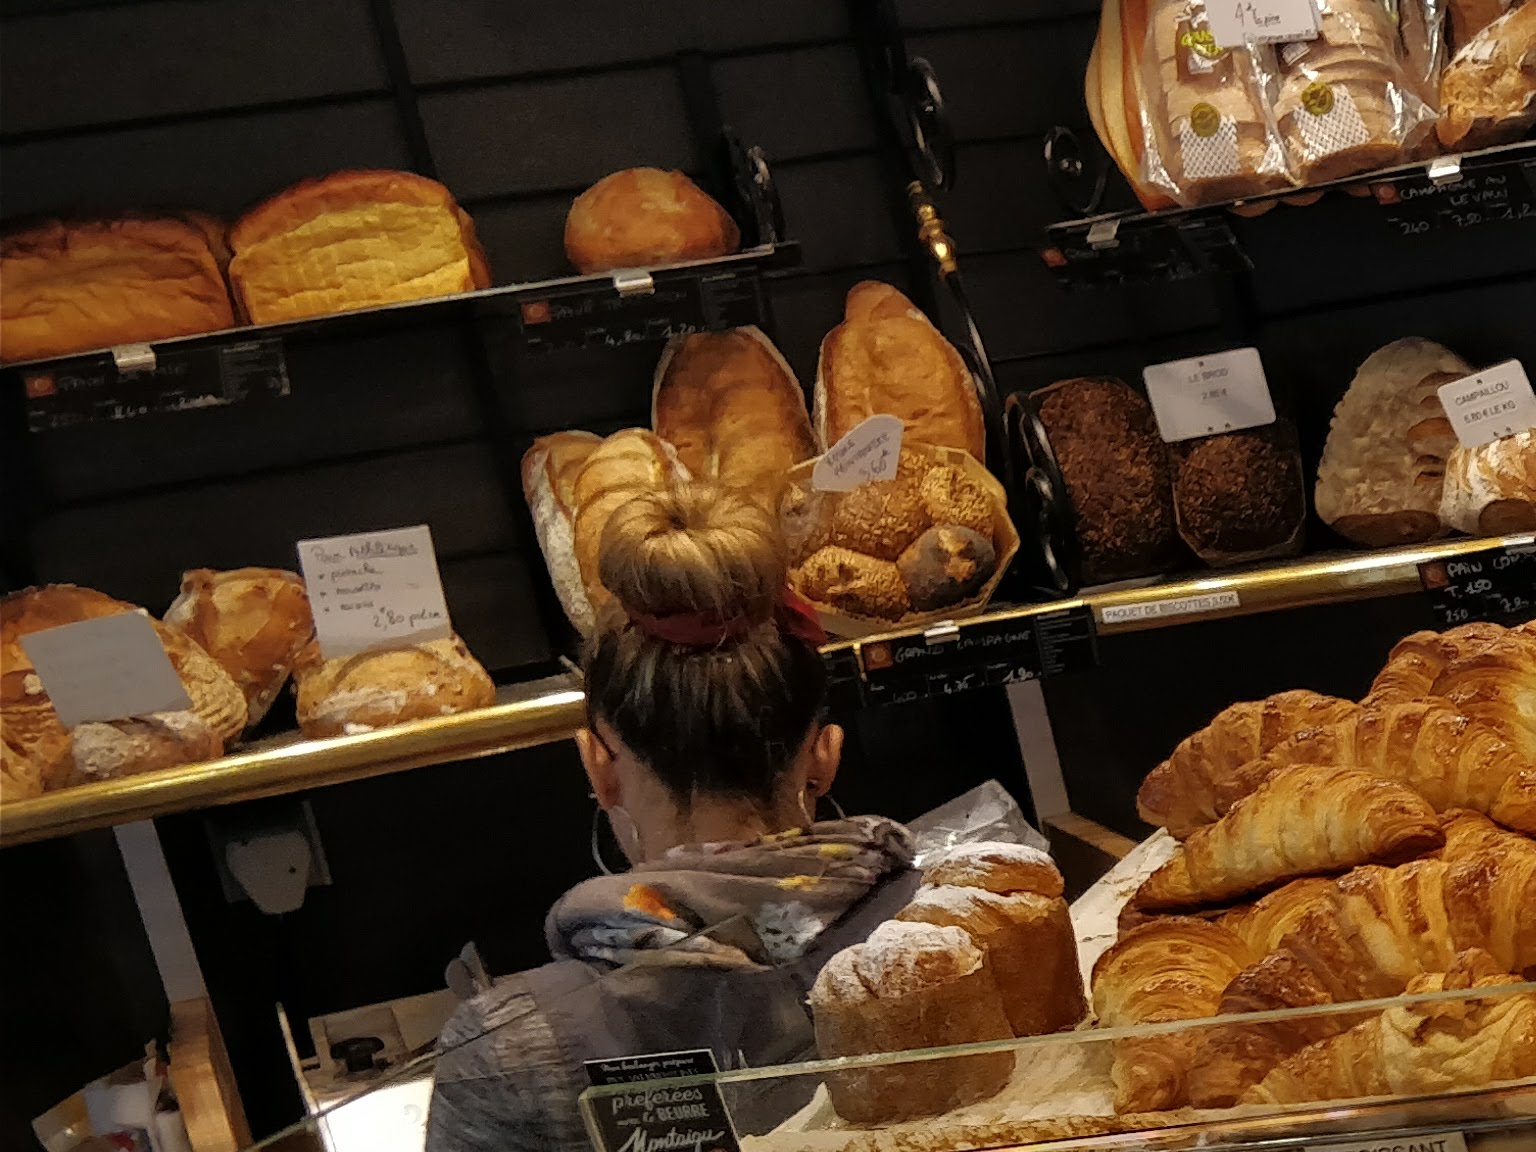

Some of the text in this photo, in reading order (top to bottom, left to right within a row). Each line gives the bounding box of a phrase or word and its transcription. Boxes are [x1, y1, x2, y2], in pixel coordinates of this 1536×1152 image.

[1489, 405, 1501, 416] LE
[1502, 400, 1516, 410] KG
[1447, 560, 1482, 578] PAIN
[656, 1103, 711, 1122] BEURRE
